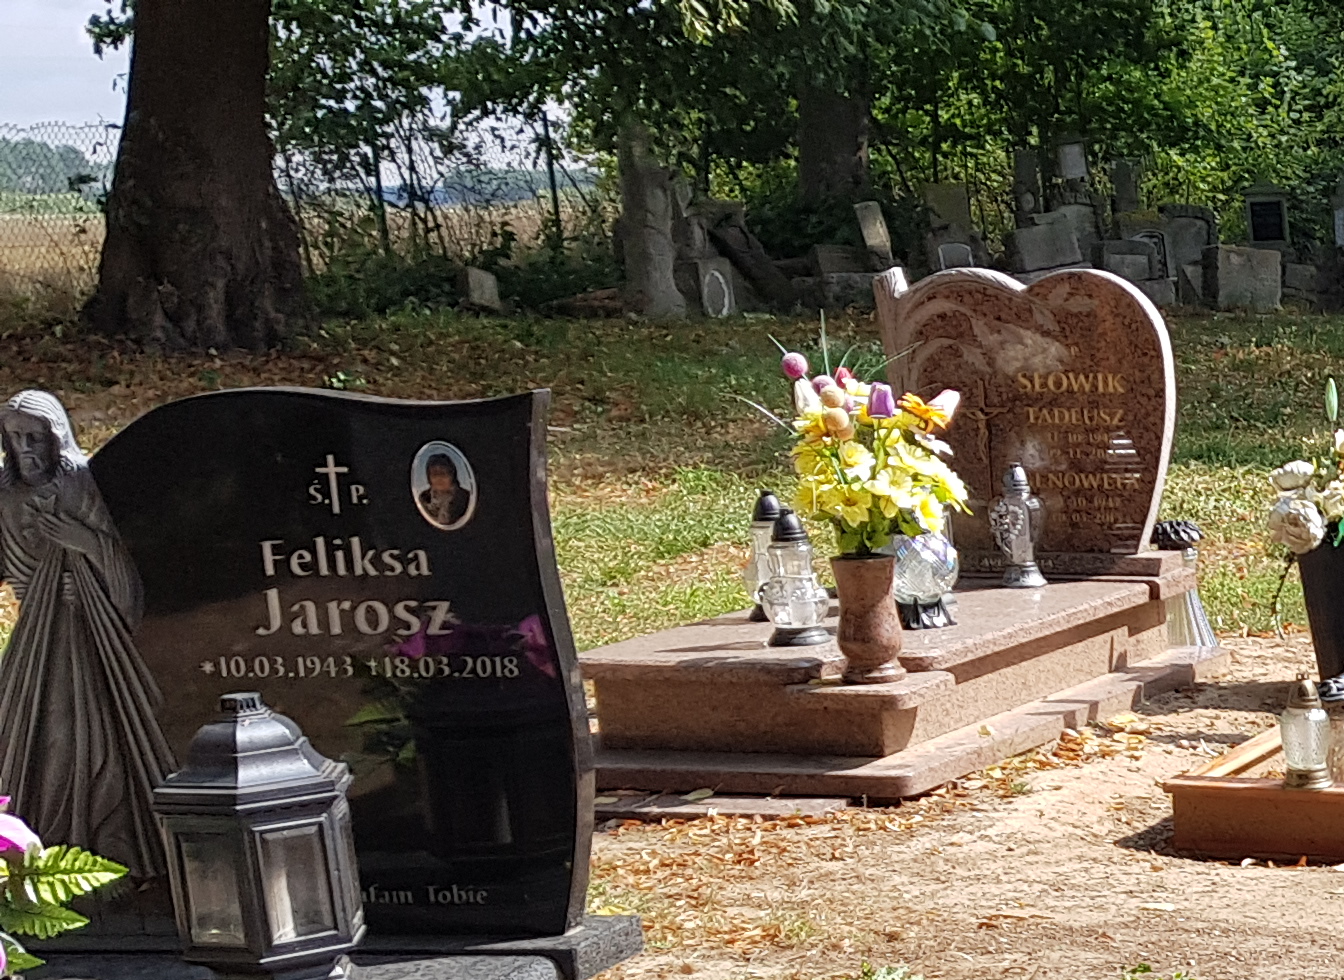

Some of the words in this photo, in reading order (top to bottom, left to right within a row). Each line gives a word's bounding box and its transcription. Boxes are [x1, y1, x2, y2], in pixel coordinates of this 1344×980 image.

[1017, 371, 1126, 395] SŁOWIK
[1025, 406, 1126, 427] TADEUSZ
[1029, 472, 1140, 490] ENOWEFA
[257, 535, 434, 578] Feliksa
[254, 586, 456, 637] Jarosz
[425, 883, 489, 905] Tobie
